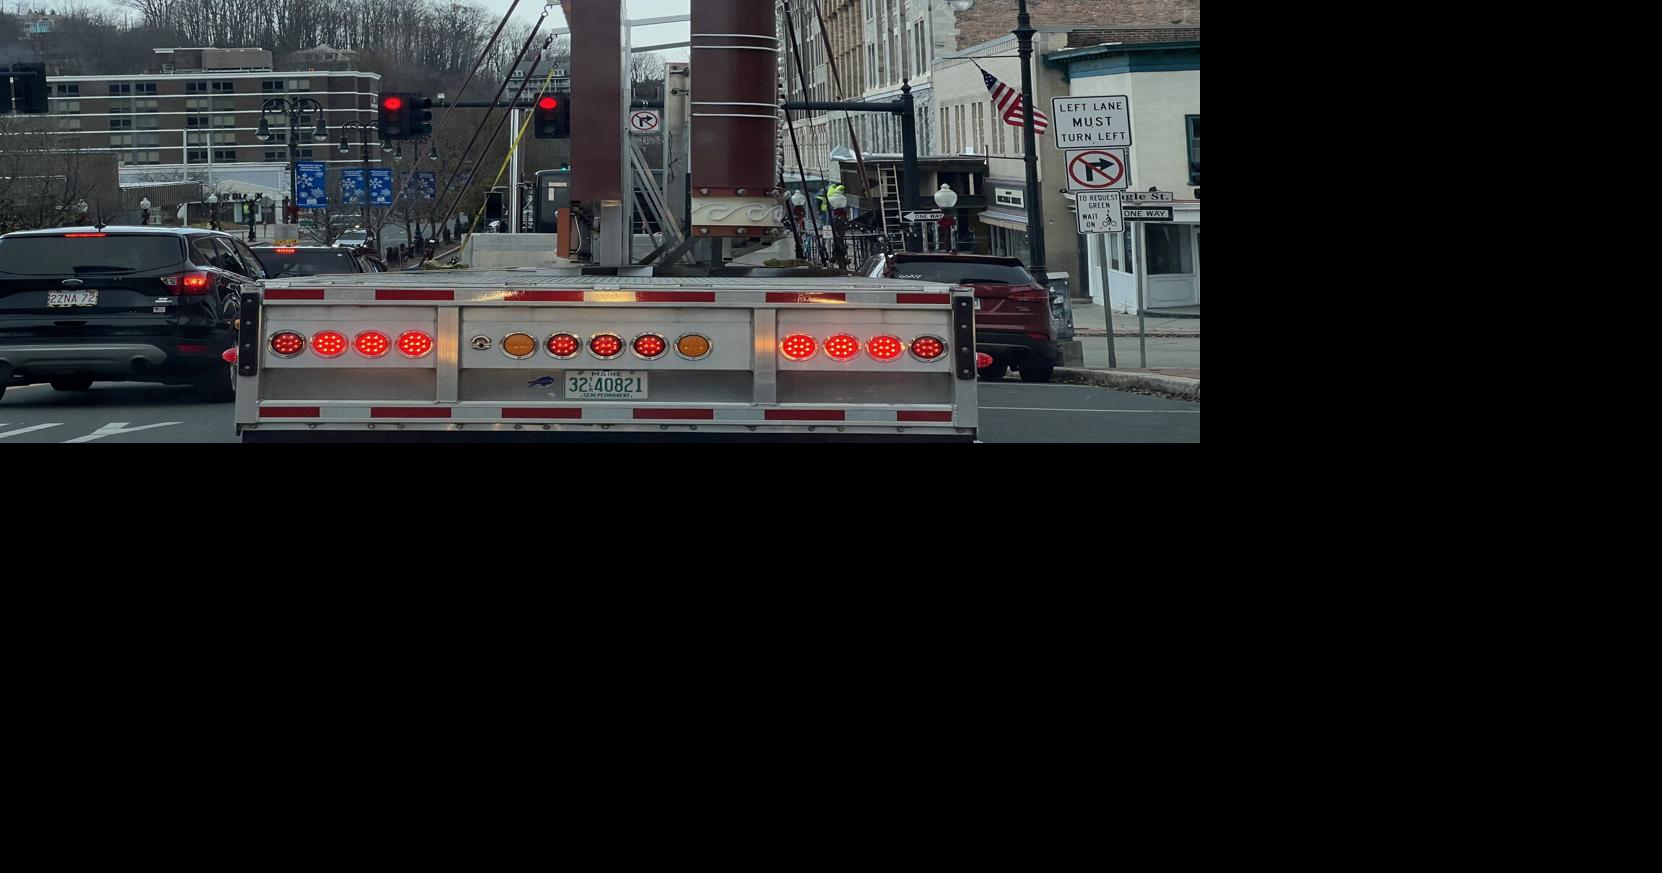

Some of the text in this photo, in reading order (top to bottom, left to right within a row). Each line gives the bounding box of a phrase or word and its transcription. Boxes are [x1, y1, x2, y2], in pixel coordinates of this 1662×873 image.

[1059, 102, 1123, 112] LEFT LANE
[1072, 116, 1112, 127] MUST
[1061, 131, 1126, 142] TURN LEFT
[232, 192, 263, 200] BLK
[1089, 193, 1118, 201] REQUEST
[1122, 192, 1169, 201] gle St.
[81, 293, 96, 303] 72
[569, 377, 643, 393] 32 40821
